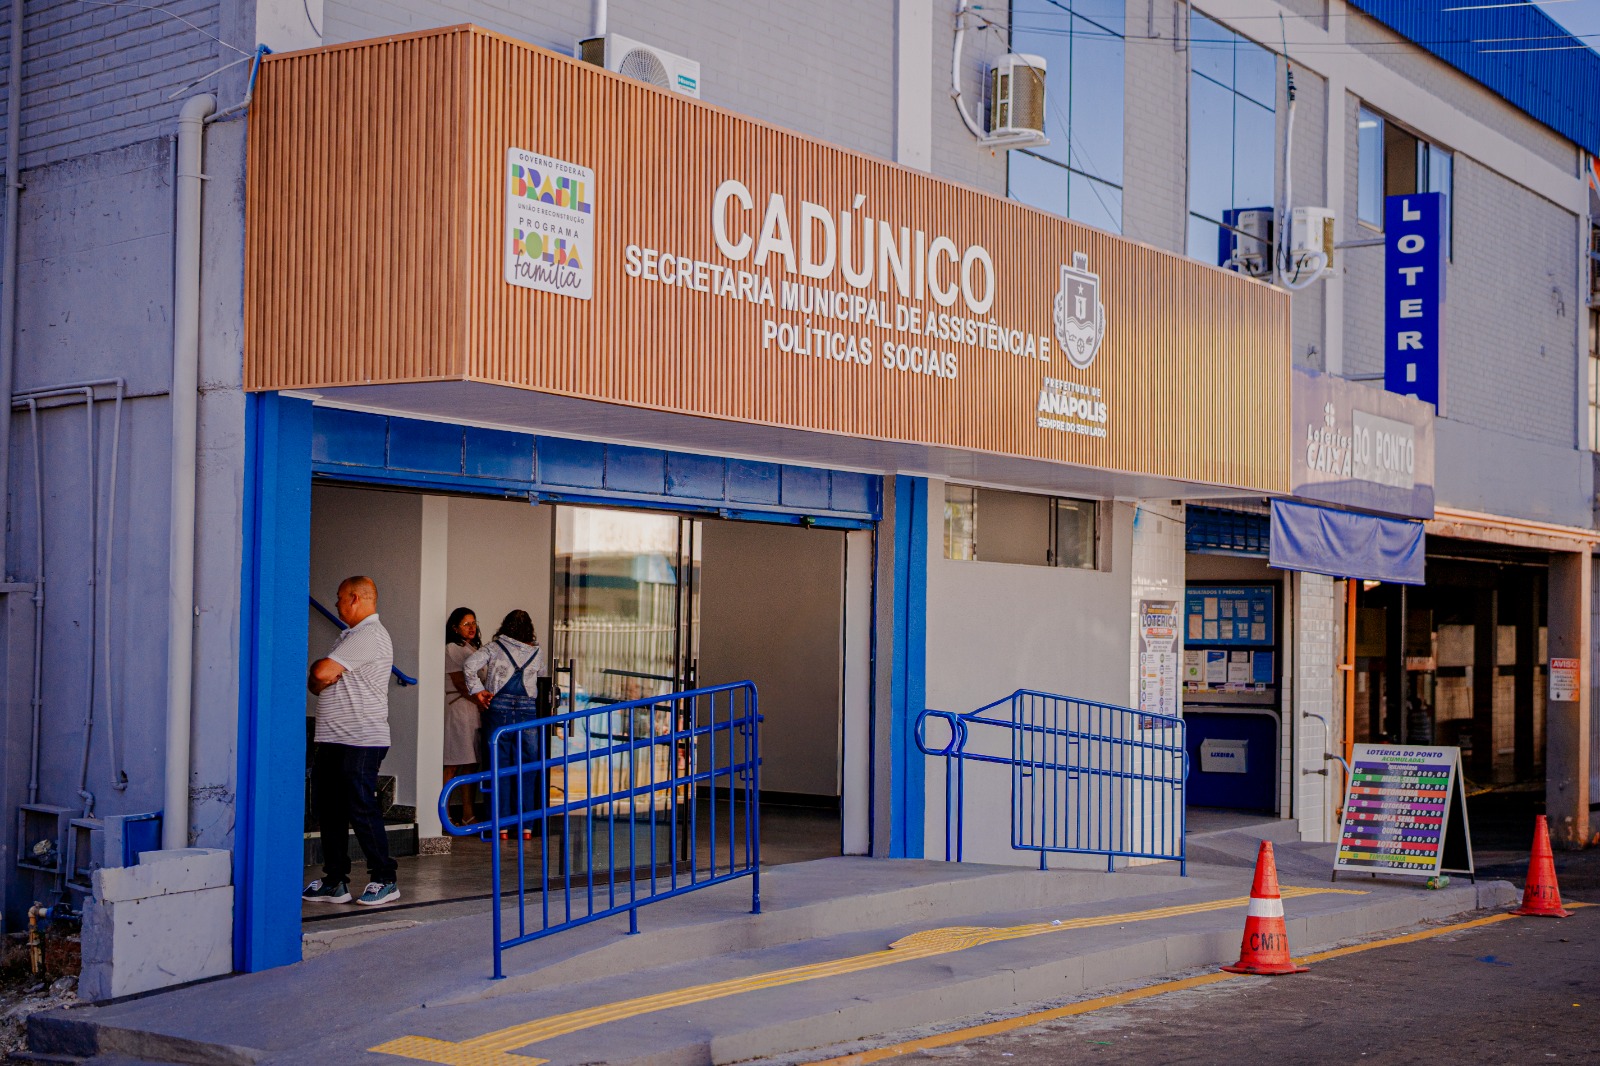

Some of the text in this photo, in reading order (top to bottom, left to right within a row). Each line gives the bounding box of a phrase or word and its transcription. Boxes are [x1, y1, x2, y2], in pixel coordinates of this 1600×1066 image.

[519, 153, 586, 178] GOVERNO FEDERAL
[512, 163, 591, 214] BRASIL
[518, 202, 536, 213] UNIÃO
[541, 208, 585, 224] RECONSTRUÇÃO
[519, 217, 579, 239] PROGRAMA
[513, 227, 583, 270] BOLSA
[712, 179, 995, 315] CADÚNICO
[514, 249, 582, 290] família
[625, 244, 1050, 363] SECRETARIA MUNICIPAL DE ASSISTÊNCIA E
[762, 318, 957, 380] POLÍTICAS SOCIAIS
[1044, 376, 1101, 398] PREFEITURA DE
[1038, 389, 1107, 424] ANÁPOLIS
[1037, 417, 1107, 438] SEMPRE DO SEU LADO
[1307, 423, 1352, 449] Loterias
[1306, 443, 1352, 476] CAIXA
[1353, 424, 1414, 474] DO PONTO
[1552, 660, 1577, 668] AVISO
[1366, 749, 1401, 757] LOTÉRICA
[1377, 787, 1418, 796] LOTOMANIA
[1373, 813, 1396, 821] DUPLA
[1376, 840, 1402, 848] LOTECA
[1369, 853, 1406, 862] TIMEMANIA
[1250, 932, 1287, 952] CMTT
